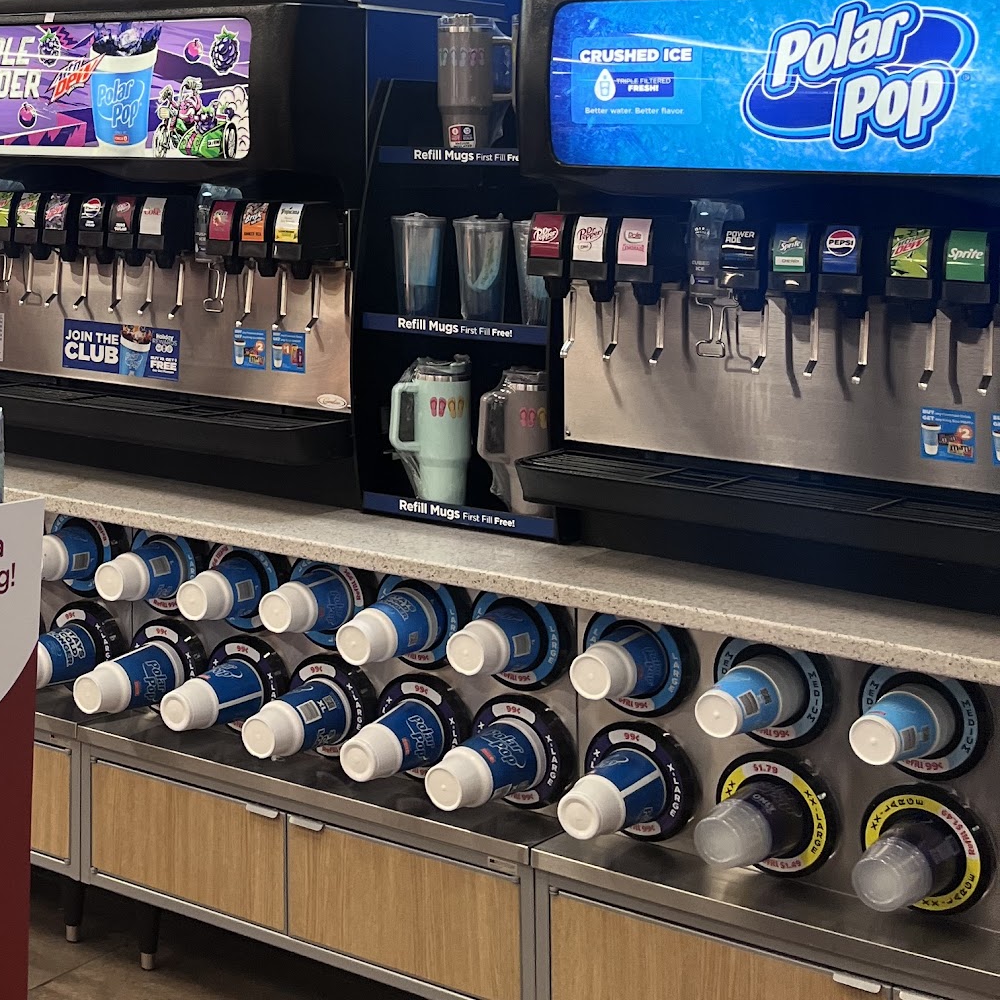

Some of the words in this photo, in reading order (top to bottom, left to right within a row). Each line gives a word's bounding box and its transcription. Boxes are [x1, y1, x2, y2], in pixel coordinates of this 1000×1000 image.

[579, 47, 660, 63] CRUSHED
[663, 47, 693, 62] ICE
[769, 5, 912, 91] Polar
[97, 78, 134, 108] Polar
[627, 84, 659, 92] FRESH!
[111, 101, 138, 128] Pop
[584, 107, 608, 115] Better
[635, 107, 658, 115] Better
[661, 107, 684, 115] flavor.
[837, 66, 945, 142] Pop
[413, 149, 442, 160] Refill
[444, 149, 475, 162] Mugs
[475, 153, 493, 161] First
[578, 228, 601, 242] Pepper
[726, 230, 755, 238] POWER
[779, 239, 803, 252] Sprite
[947, 247, 985, 261] Sprite
[65, 329, 93, 343] JOIN
[95, 332, 120, 345] THE
[397, 317, 426, 330] Refill
[428, 320, 459, 334] Mugs
[460, 326, 477, 335] First
[479, 327, 491, 335] Fill
[491, 328, 513, 337] Free!
[64, 341, 120, 365] CLUB
[150, 360, 178, 371] FREE
[399, 499, 428, 514] Refill
[430, 504, 460, 520] Mugs
[462, 512, 480, 522] First
[481, 515, 493, 524] Fill
[494, 517, 516, 528] Free!
[549, 625, 558, 665] LARGE
[670, 652, 682, 693] LARGE
[414, 684, 429, 695] 99¢
[807, 671, 821, 723] MEDIUM
[506, 705, 521, 715] 99¢
[407, 713, 436, 750] Polar
[623, 731, 640, 742] 99¢
[961, 699, 977, 754] MEDIUM
[544, 734, 559, 787] X-LARGE
[752, 762, 778, 775] $1.79
[667, 763, 682, 819] X-LARGE
[804, 789, 825, 855] XX-LARGE
[870, 797, 924, 831] XX-LARGE
[921, 872, 976, 908] XX-LARGE
